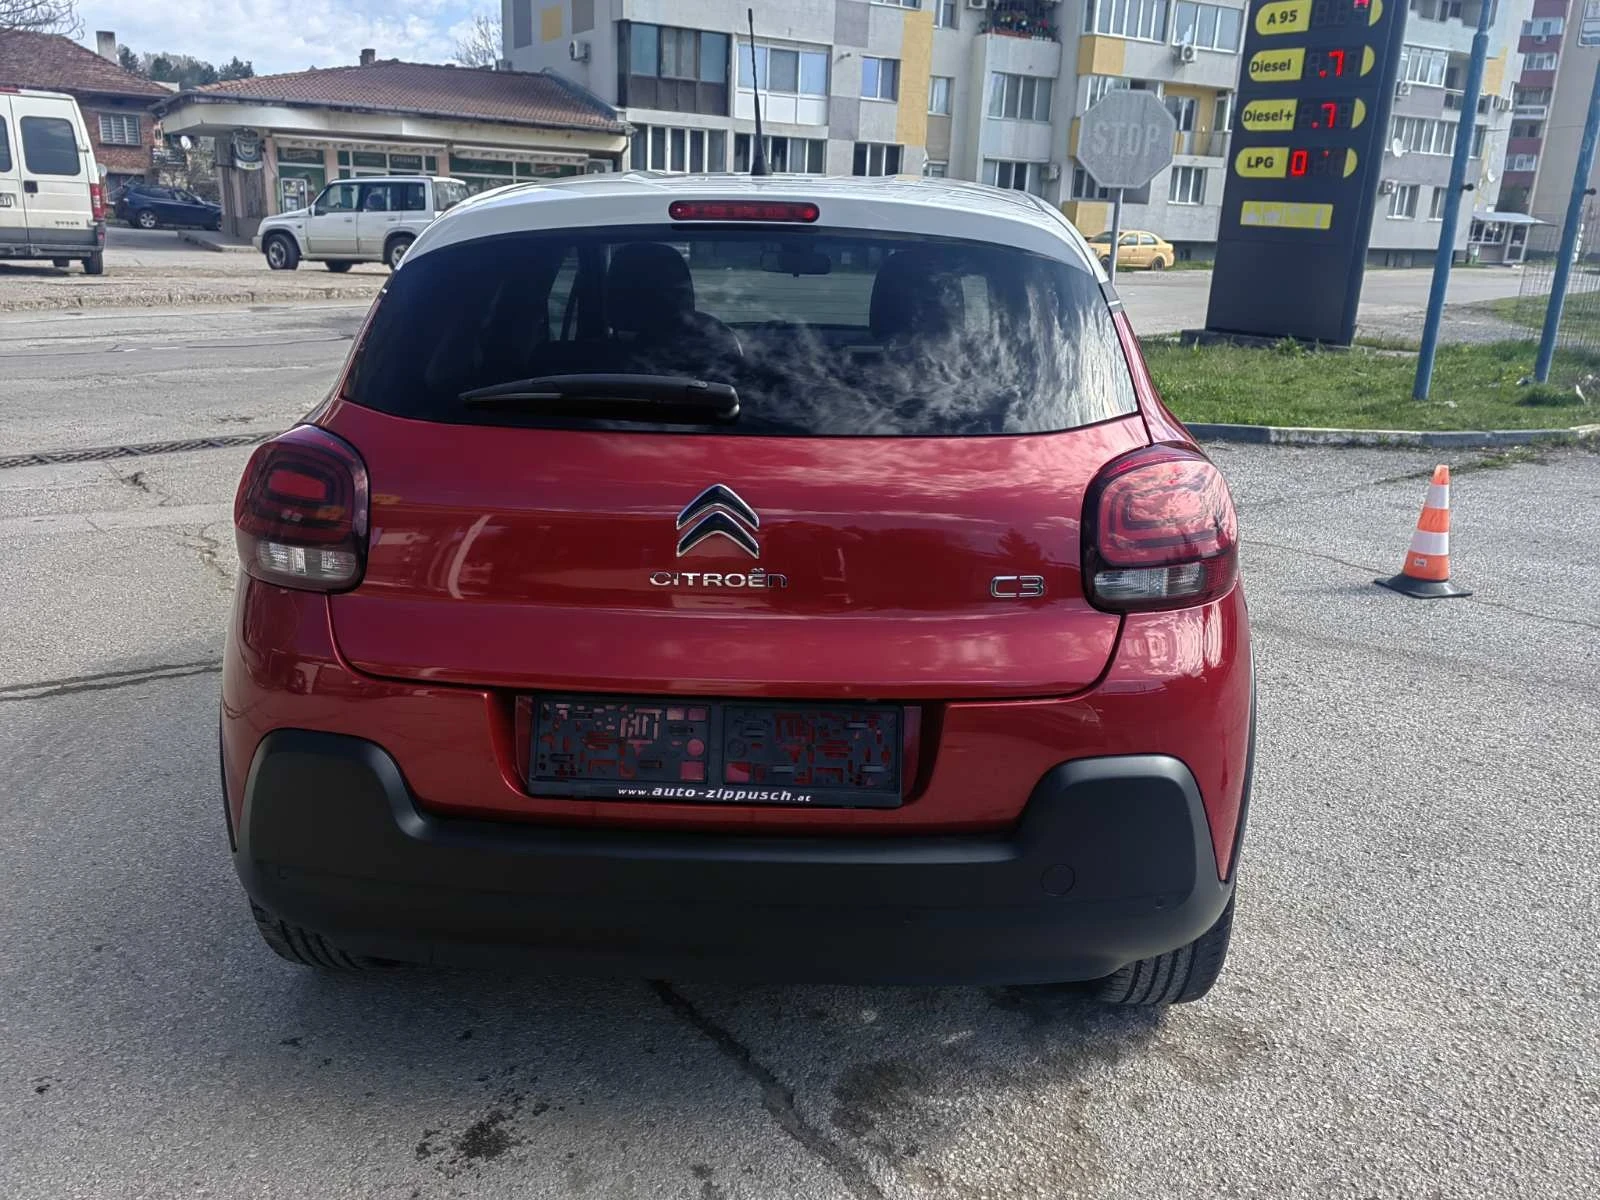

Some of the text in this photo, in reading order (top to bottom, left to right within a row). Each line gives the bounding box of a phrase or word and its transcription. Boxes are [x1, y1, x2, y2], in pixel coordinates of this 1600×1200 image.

[1267, 10, 1298, 25] A 95
[1251, 59, 1292, 73] Diesel
[1243, 108, 1293, 123] Diesel+
[1091, 122, 1162, 156] STOP
[1247, 155, 1275, 169] LPG
[990, 575, 1046, 598] C3
